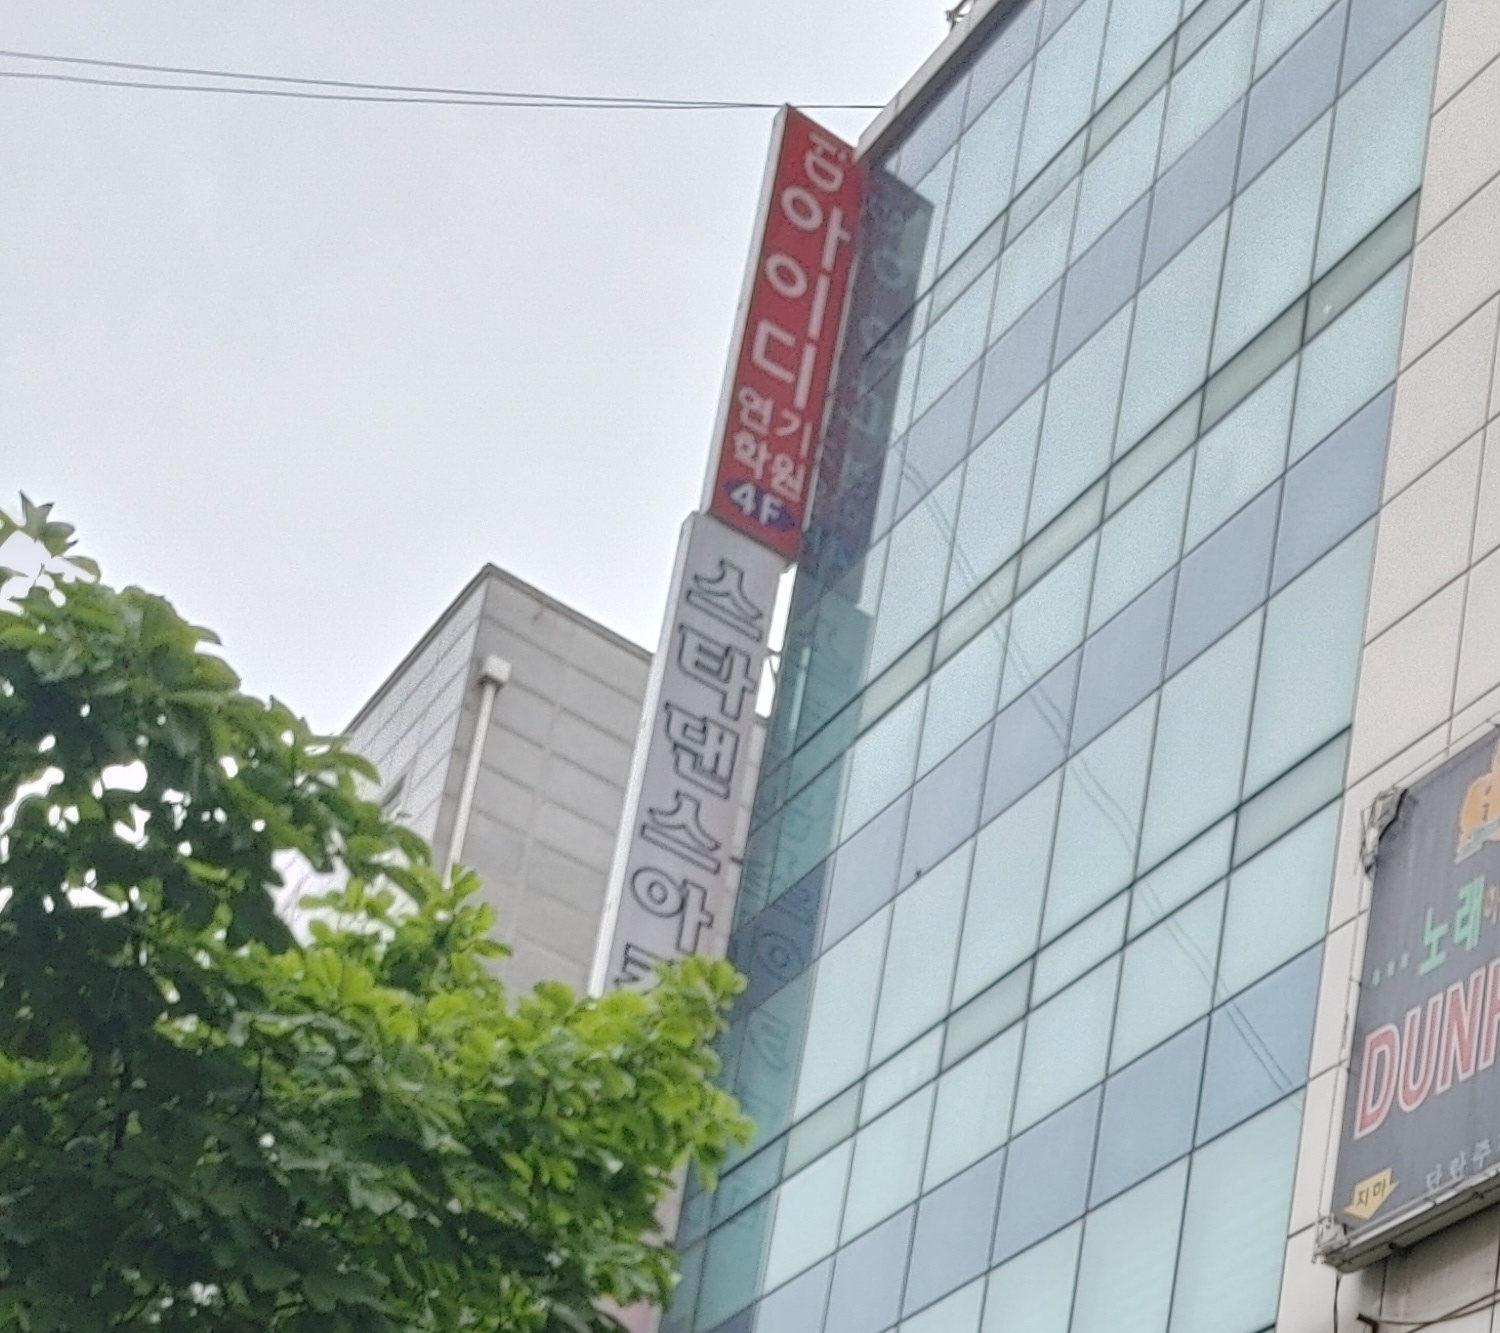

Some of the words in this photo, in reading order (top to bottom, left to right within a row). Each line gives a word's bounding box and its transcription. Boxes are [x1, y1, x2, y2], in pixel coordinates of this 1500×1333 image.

[750, 187, 850, 408] 아이디
[729, 482, 783, 524] 4F
[615, 559, 763, 995] 스타댄스아
